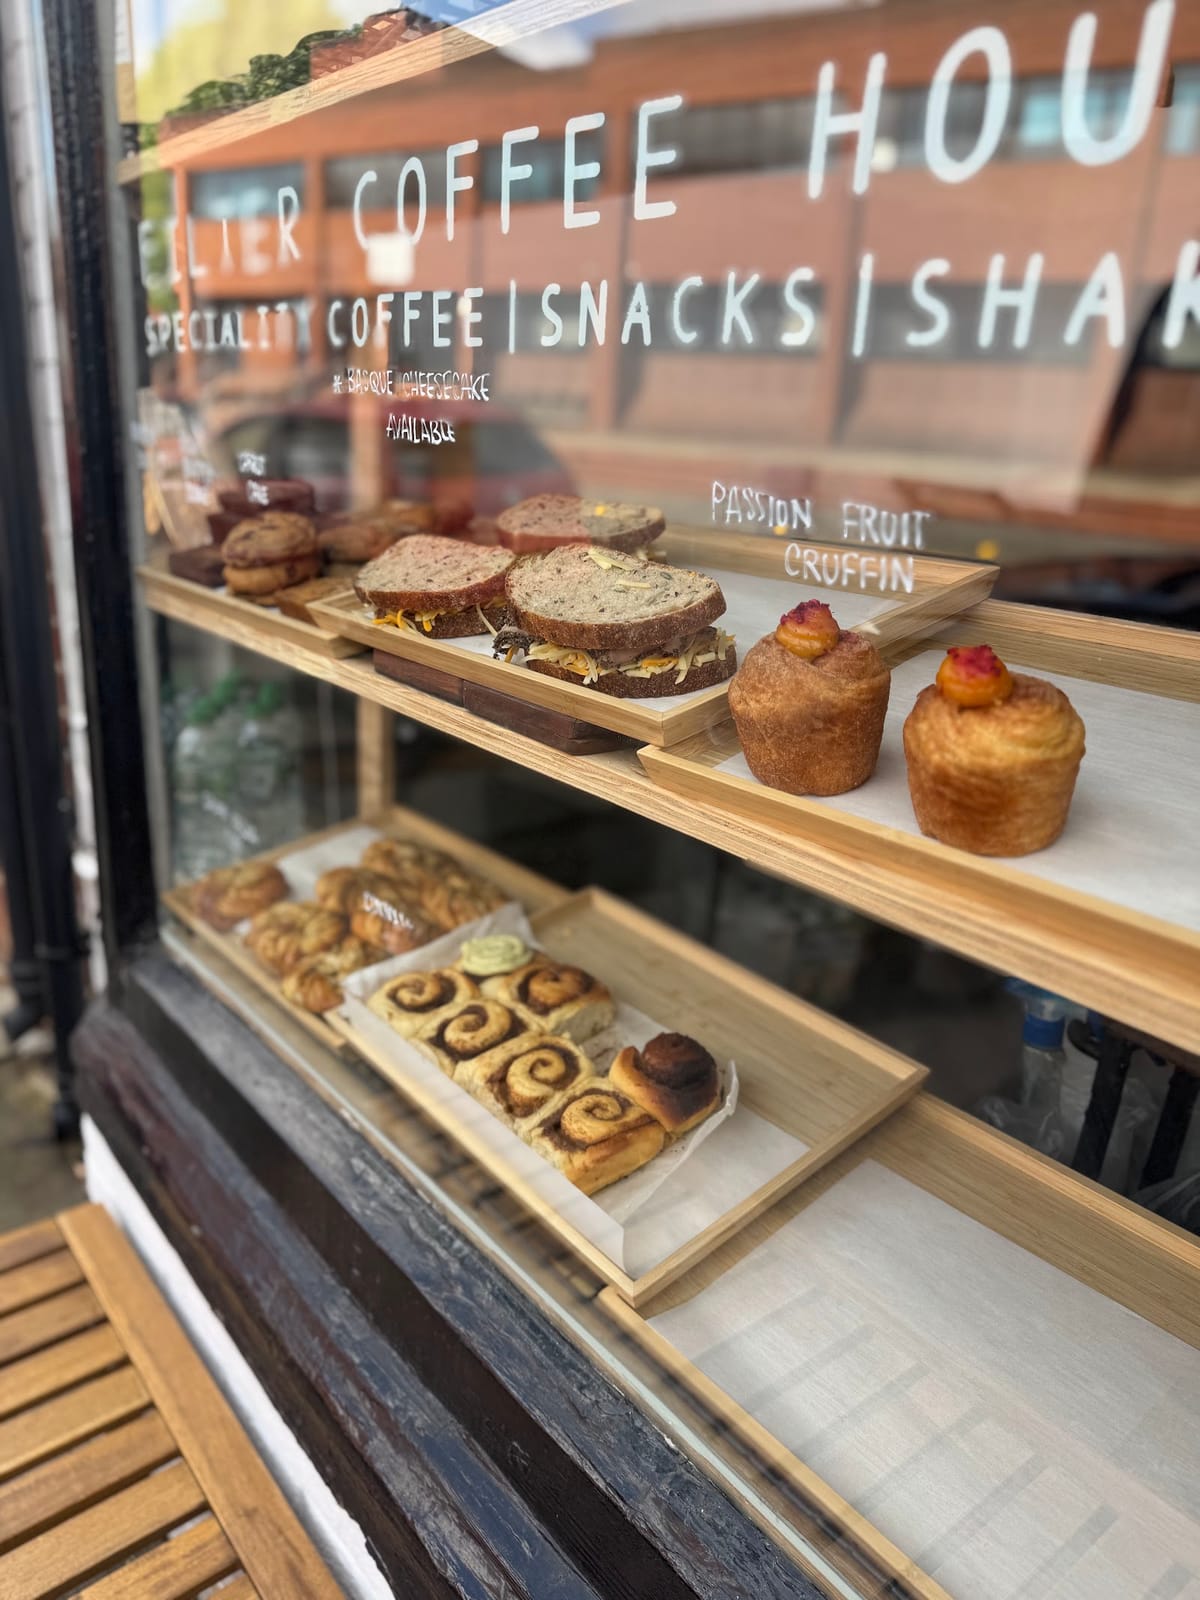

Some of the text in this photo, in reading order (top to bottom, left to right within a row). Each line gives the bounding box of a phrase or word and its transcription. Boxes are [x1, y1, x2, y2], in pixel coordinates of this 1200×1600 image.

[353, 95, 683, 251] COFFEE
[328, 287, 484, 347] COFFEE
[541, 267, 815, 347] SNACKS
[347, 367, 490, 401] BASQUE CHEESECAKE
[386, 413, 456, 445] AVAILABLE
[712, 481, 930, 549] PASSION FRUIT
[784, 543, 914, 594] CRUFFIN
